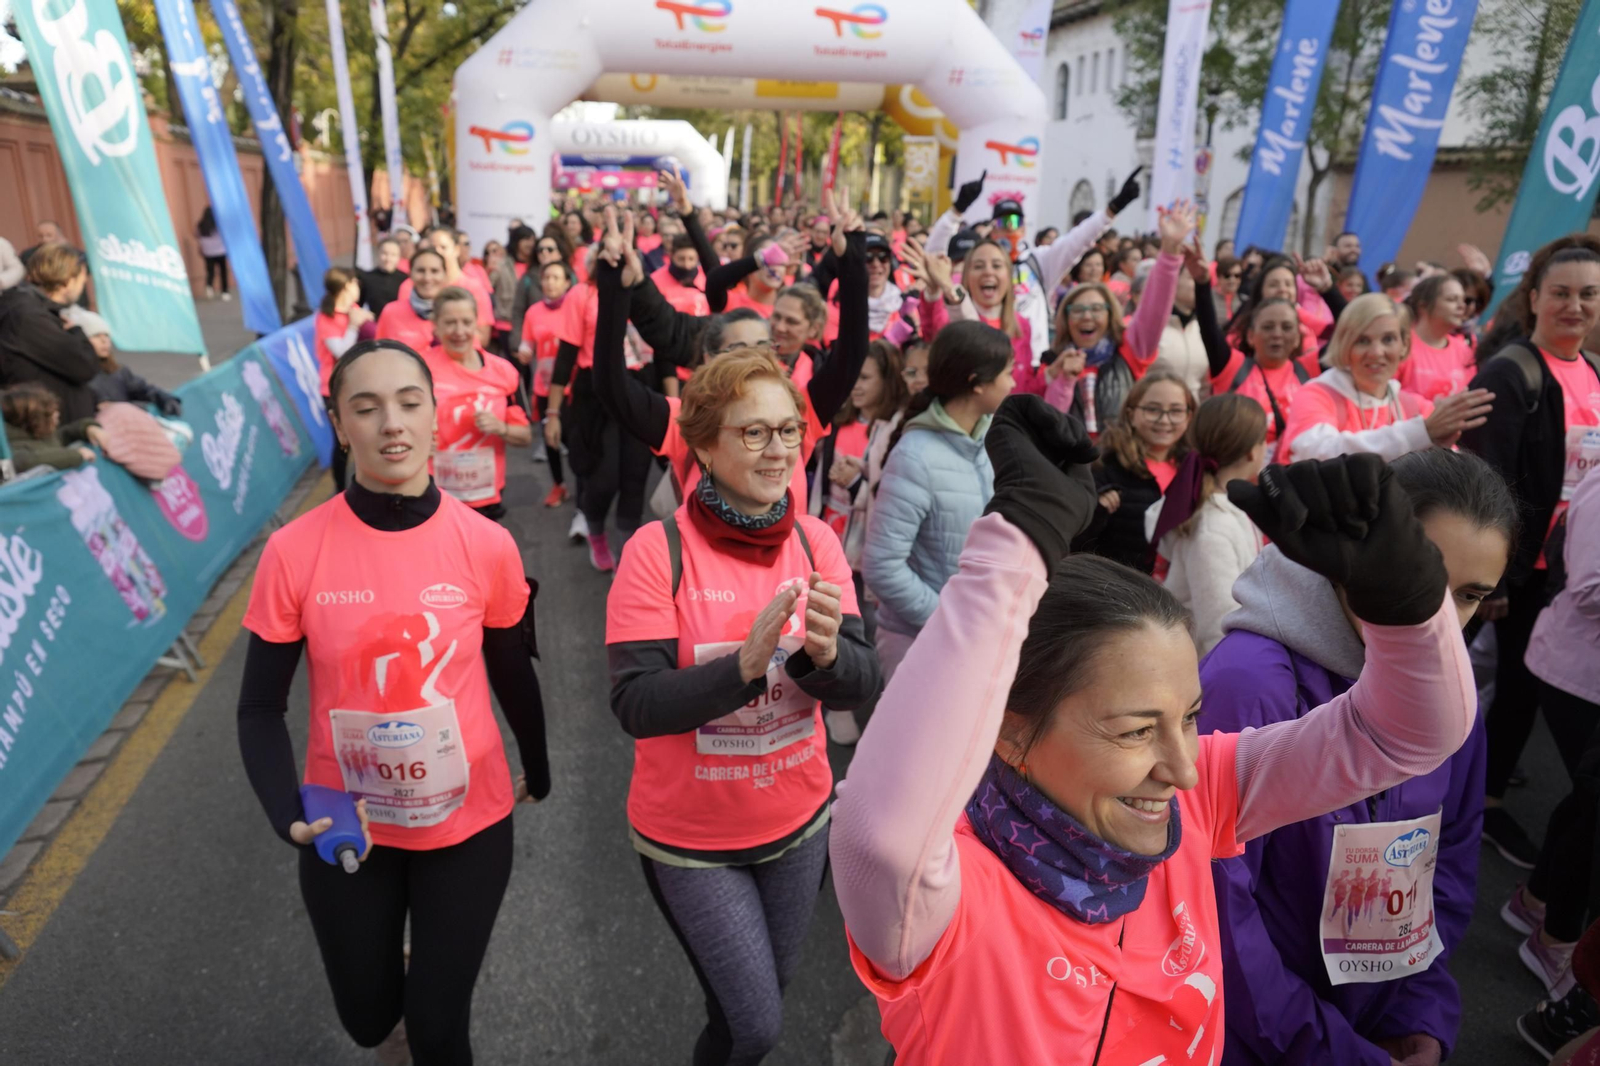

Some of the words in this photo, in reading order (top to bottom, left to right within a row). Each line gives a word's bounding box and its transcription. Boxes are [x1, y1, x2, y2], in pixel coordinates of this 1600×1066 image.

[1373, 0, 1459, 161] Marlene
[1258, 37, 1318, 176] Marlene
[571, 125, 659, 147] OYSHO
[316, 590, 374, 605] OYSHO
[372, 731, 420, 742] ASTURIANA
[712, 739, 755, 749] OYSHO
[695, 765, 750, 781] CARRERA
[752, 762, 768, 777] DE
[770, 758, 784, 773] LA
[786, 744, 816, 770] MUJER
[378, 762, 427, 781] 016
[364, 807, 396, 819] YSHO
[1345, 854, 1379, 863] SUMA
[1345, 942, 1383, 951] CARRERA
[1385, 942, 1395, 951] DE
[1397, 942, 1405, 950] LA
[1339, 960, 1393, 972] OYSHO
